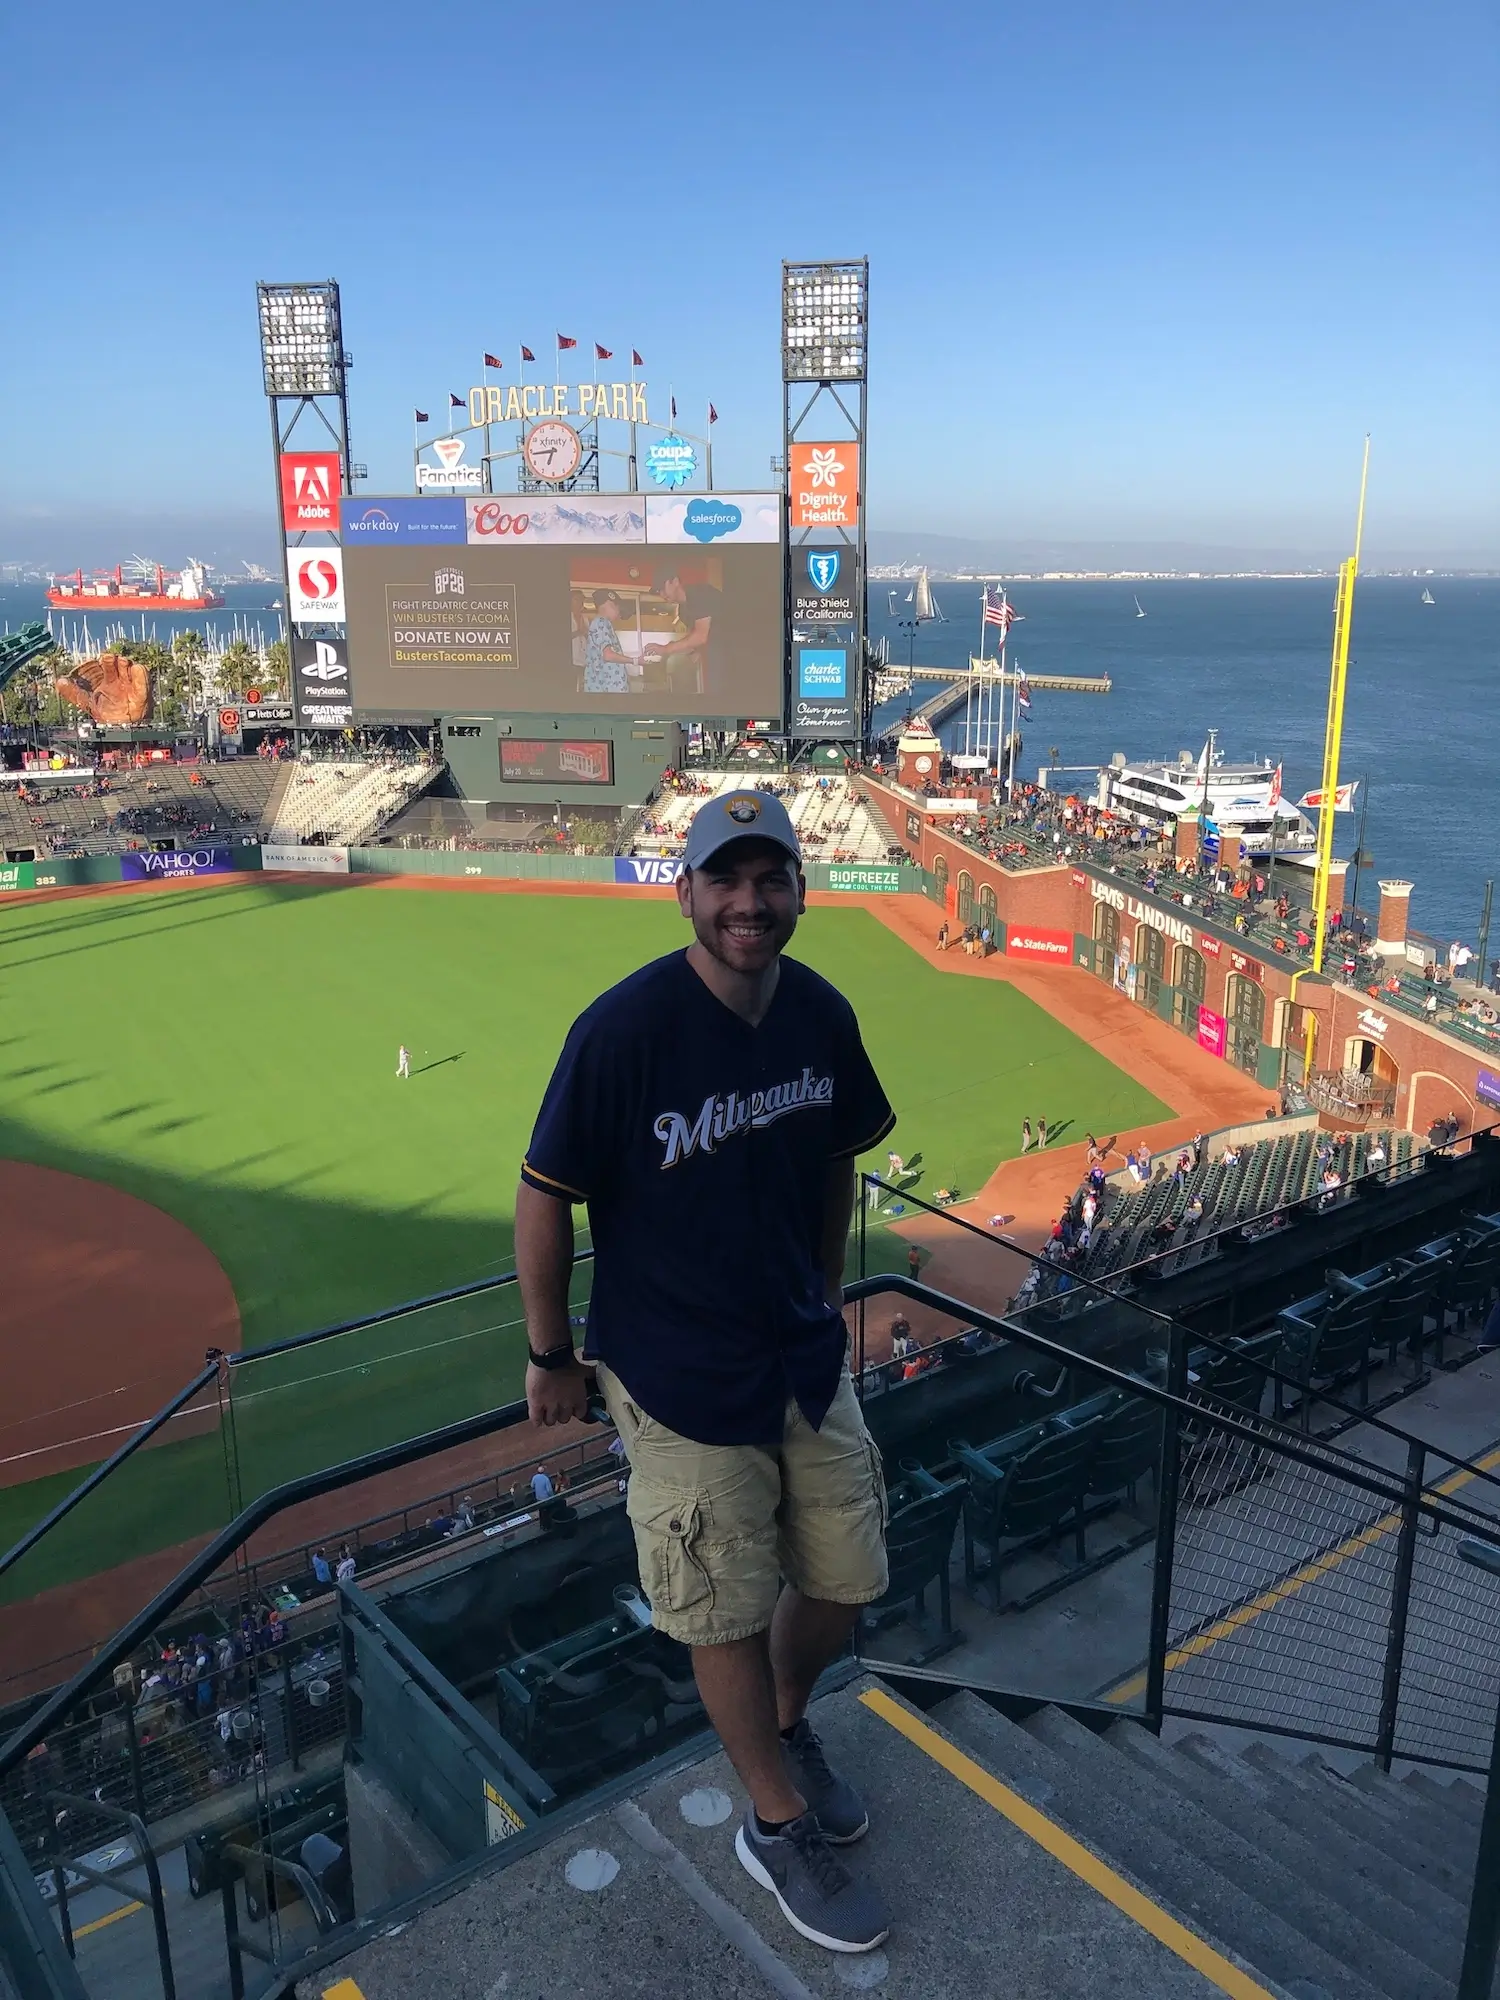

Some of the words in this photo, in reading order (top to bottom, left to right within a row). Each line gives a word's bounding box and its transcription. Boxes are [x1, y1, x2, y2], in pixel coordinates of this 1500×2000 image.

[469, 385, 569, 427] ORACLE
[578, 383, 650, 424] PARK
[540, 437, 567, 447] xfinity
[650, 445, 694, 464] coupa
[419, 468, 481, 483] Fanatics
[799, 492, 848, 509] Dignity
[297, 505, 331, 519] Adobe
[473, 502, 529, 536] Coo
[690, 514, 737, 525] salesforce
[349, 519, 400, 533] workday
[434, 573, 465, 595] BP28
[300, 601, 339, 609] SAFEWAY
[392, 600, 420, 610] FIGHT
[421, 600, 469, 610] PEDIATRIC
[470, 600, 509, 610] CANCER
[797, 598, 818, 608] Blue
[820, 598, 850, 608] Shield
[393, 613, 414, 623] WIN
[417, 613, 463, 623] BUSTER'S
[466, 613, 510, 623] TACOMA
[793, 609, 804, 619] of
[806, 609, 854, 619] California
[394, 631, 451, 643] DONATE
[455, 632, 490, 644] NOW
[494, 632, 511, 644] AT
[395, 650, 512, 662] BustersTacoma.com
[804, 662, 841, 675] charles
[804, 675, 842, 683] SCHWAB
[272, 709, 291, 719] Coffee
[301, 705, 353, 716] GREATNESS
[797, 702, 820, 714] Own
[821, 707, 848, 719] your
[311, 714, 348, 724] AWAITS.
[796, 715, 851, 726] tomorrow
[139, 849, 215, 873] YAHOO!
[163, 868, 195, 878] SPORTS
[465, 866, 482, 875] 399
[36, 877, 56, 886] 382
[1128, 896, 1193, 947] LANDING
[653, 1066, 835, 1170] Milwauke
